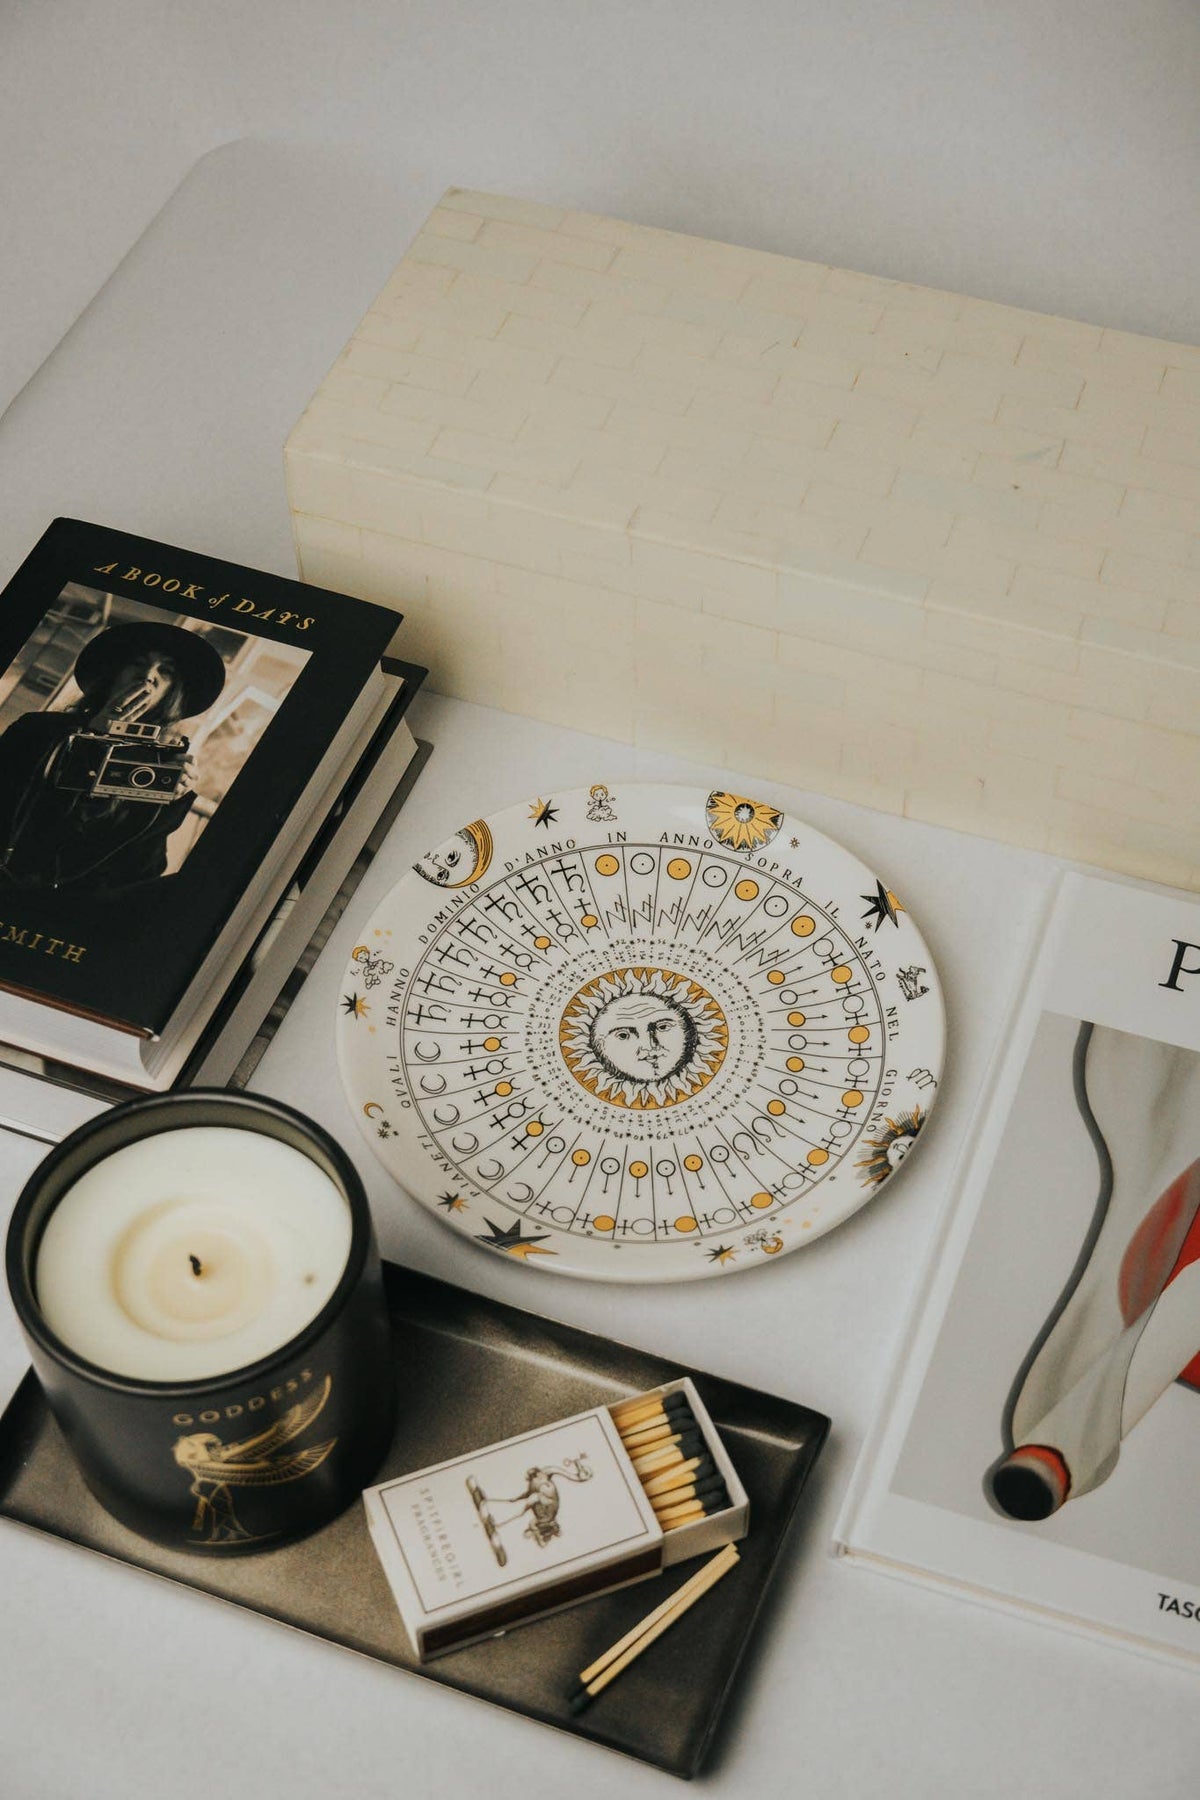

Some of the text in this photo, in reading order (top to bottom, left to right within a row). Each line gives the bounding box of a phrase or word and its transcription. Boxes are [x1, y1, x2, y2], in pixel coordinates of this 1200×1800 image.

[94, 562, 315, 630] A BOOK of DAYS
[504, 838, 577, 872] D'ANNO
[608, 831, 627, 843] IN
[659, 831, 714, 849] ANNO
[745, 852, 803, 888] SOPRA
[418, 882, 480, 944] DOMINIO
[824, 900, 840, 919] IL
[0, 921, 87, 963] MITH
[855, 936, 886, 982] NATO
[386, 968, 410, 1026] HANNO
[886, 1006, 899, 1042] NEL
[866, 1069, 898, 1132] GIORNO
[417, 1134, 480, 1197] PIANETI
